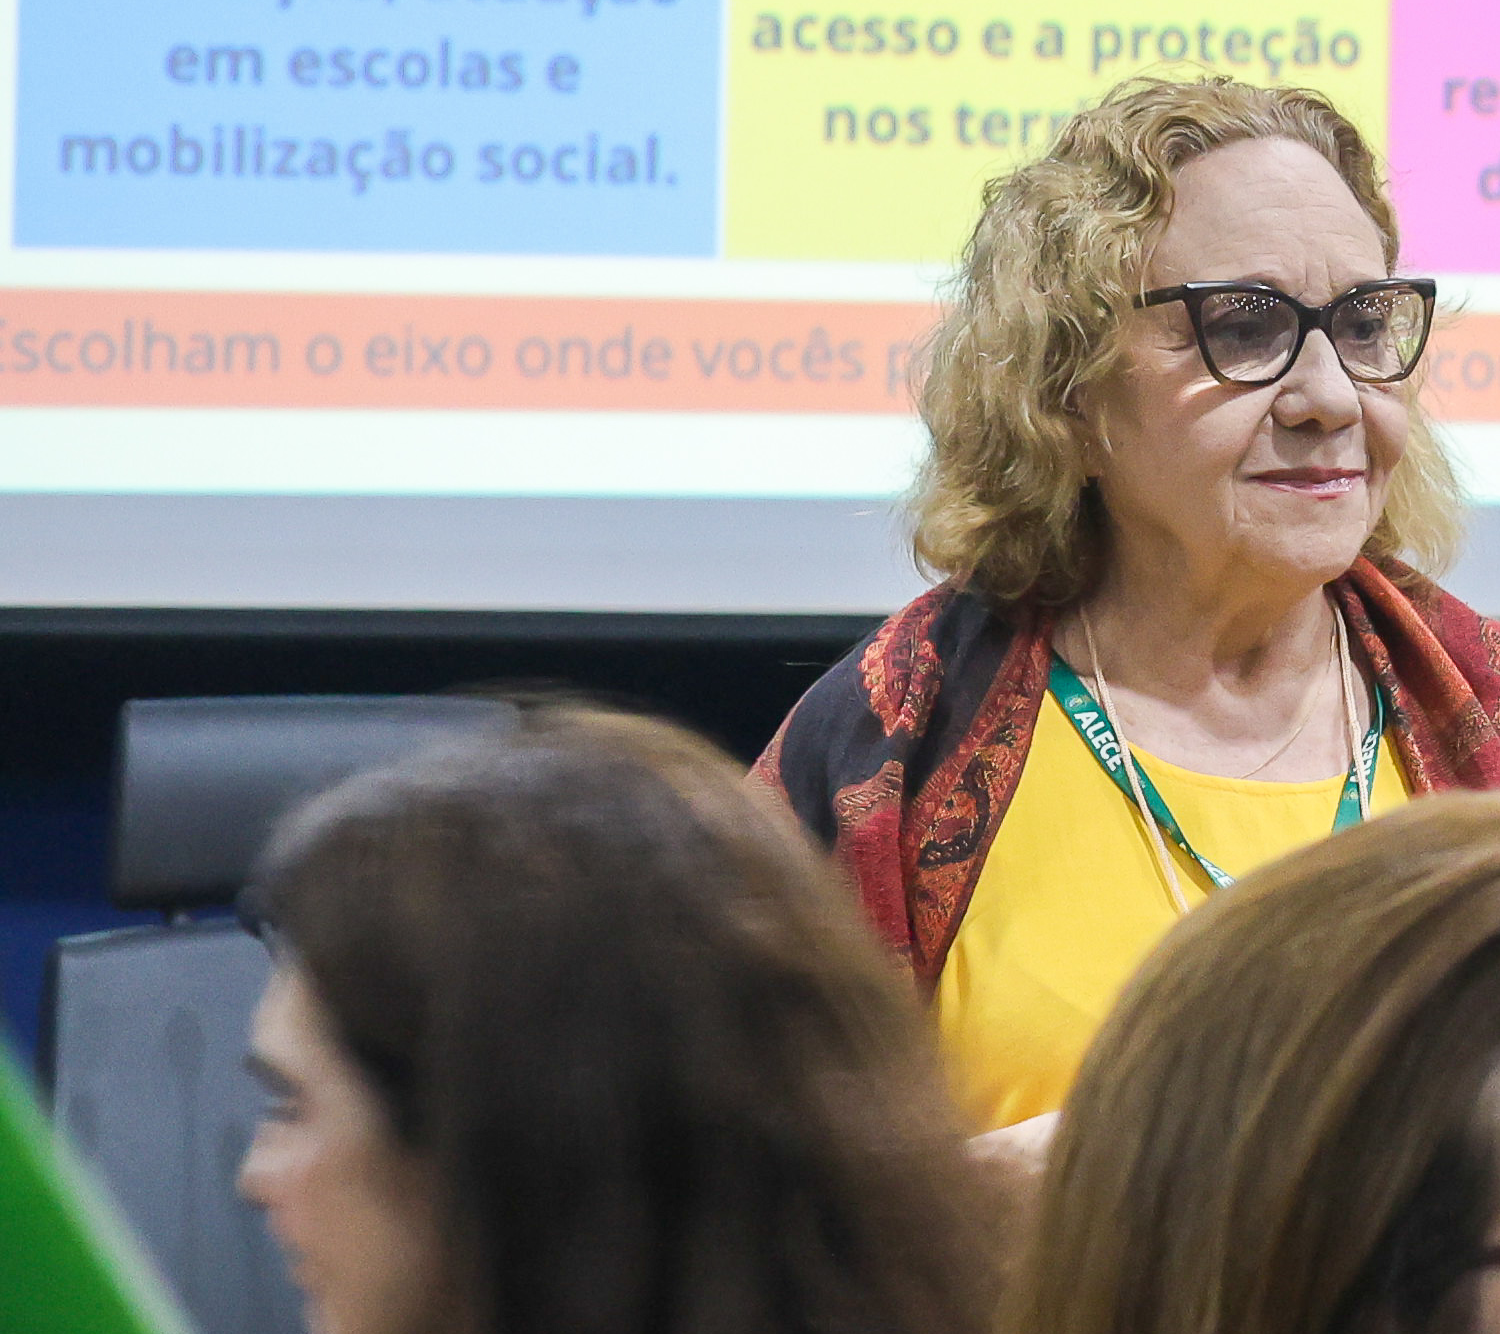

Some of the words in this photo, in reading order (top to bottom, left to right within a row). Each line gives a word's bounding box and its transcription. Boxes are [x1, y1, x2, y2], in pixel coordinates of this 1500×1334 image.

[165, 45, 265, 85] em
[287, 39, 526, 92] escolas
[546, 54, 581, 94] e
[751, 12, 961, 57] acesso
[980, 19, 1014, 59] e
[1033, 22, 1066, 61] a
[1091, 18, 1361, 76] proteção
[824, 101, 931, 145] nos
[955, 100, 1092, 146] terr
[60, 124, 456, 195] mobilização
[478, 133, 677, 186] social.
[304, 333, 344, 376] o
[363, 326, 494, 378] eixo
[514, 325, 674, 381] onde
[691, 326, 865, 382] vocês
[1074, 712, 1123, 771] ALECE
